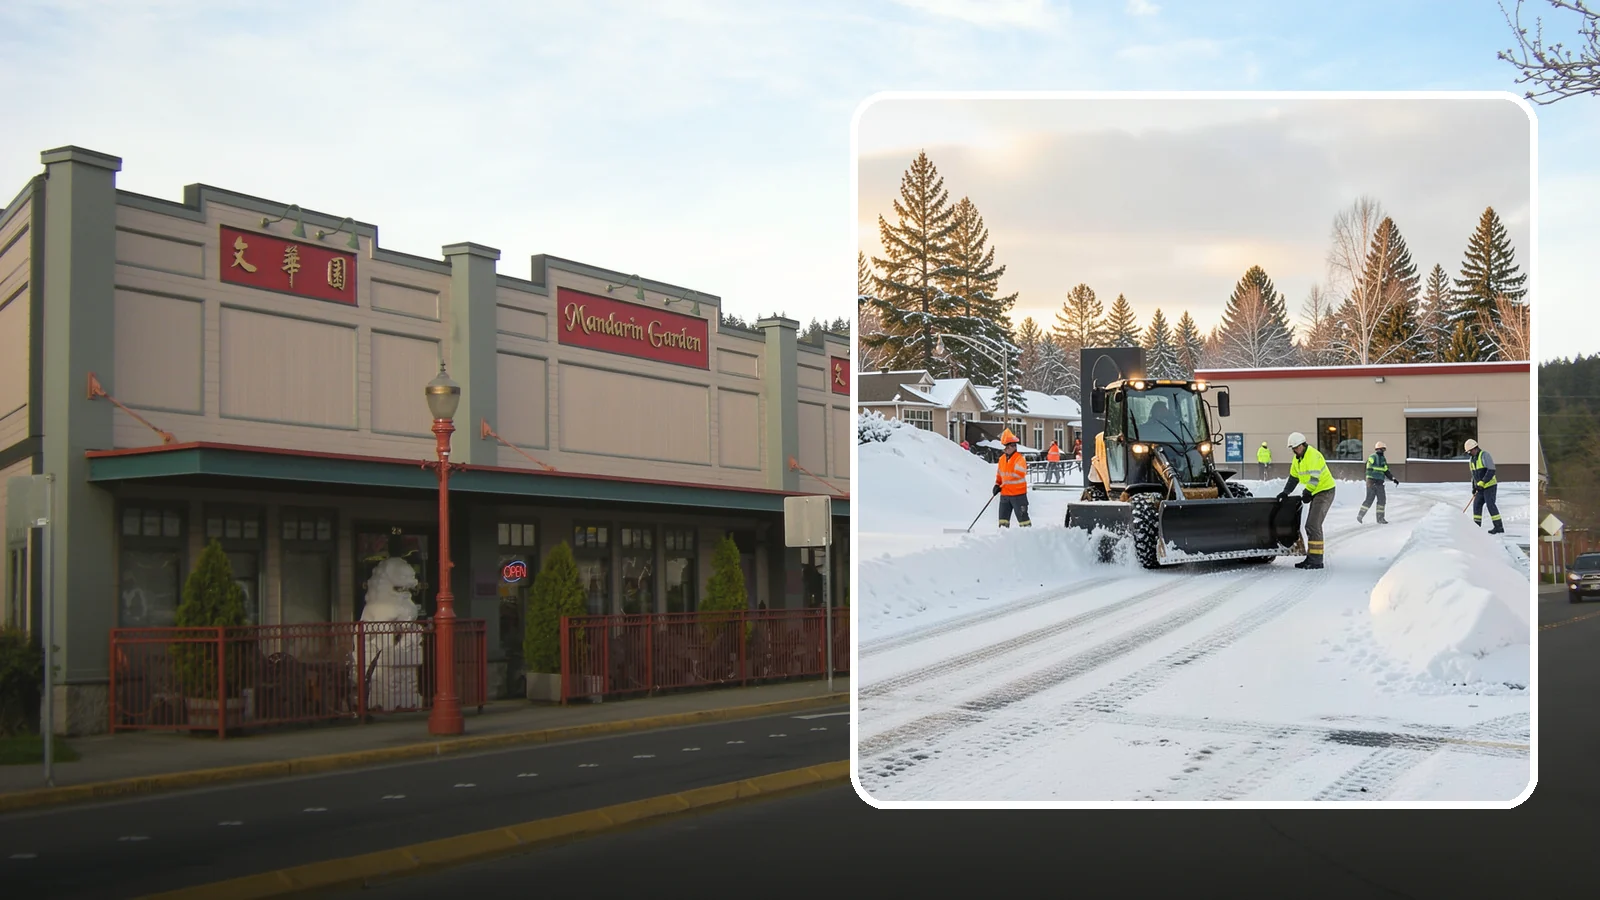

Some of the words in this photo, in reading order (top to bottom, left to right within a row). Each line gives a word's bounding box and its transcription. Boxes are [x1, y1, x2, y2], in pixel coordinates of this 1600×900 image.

[231, 235, 346, 291] 文華園
[564, 302, 644, 341] Mandarin
[648, 320, 701, 352] Garden
[503, 565, 527, 578] OPEN
